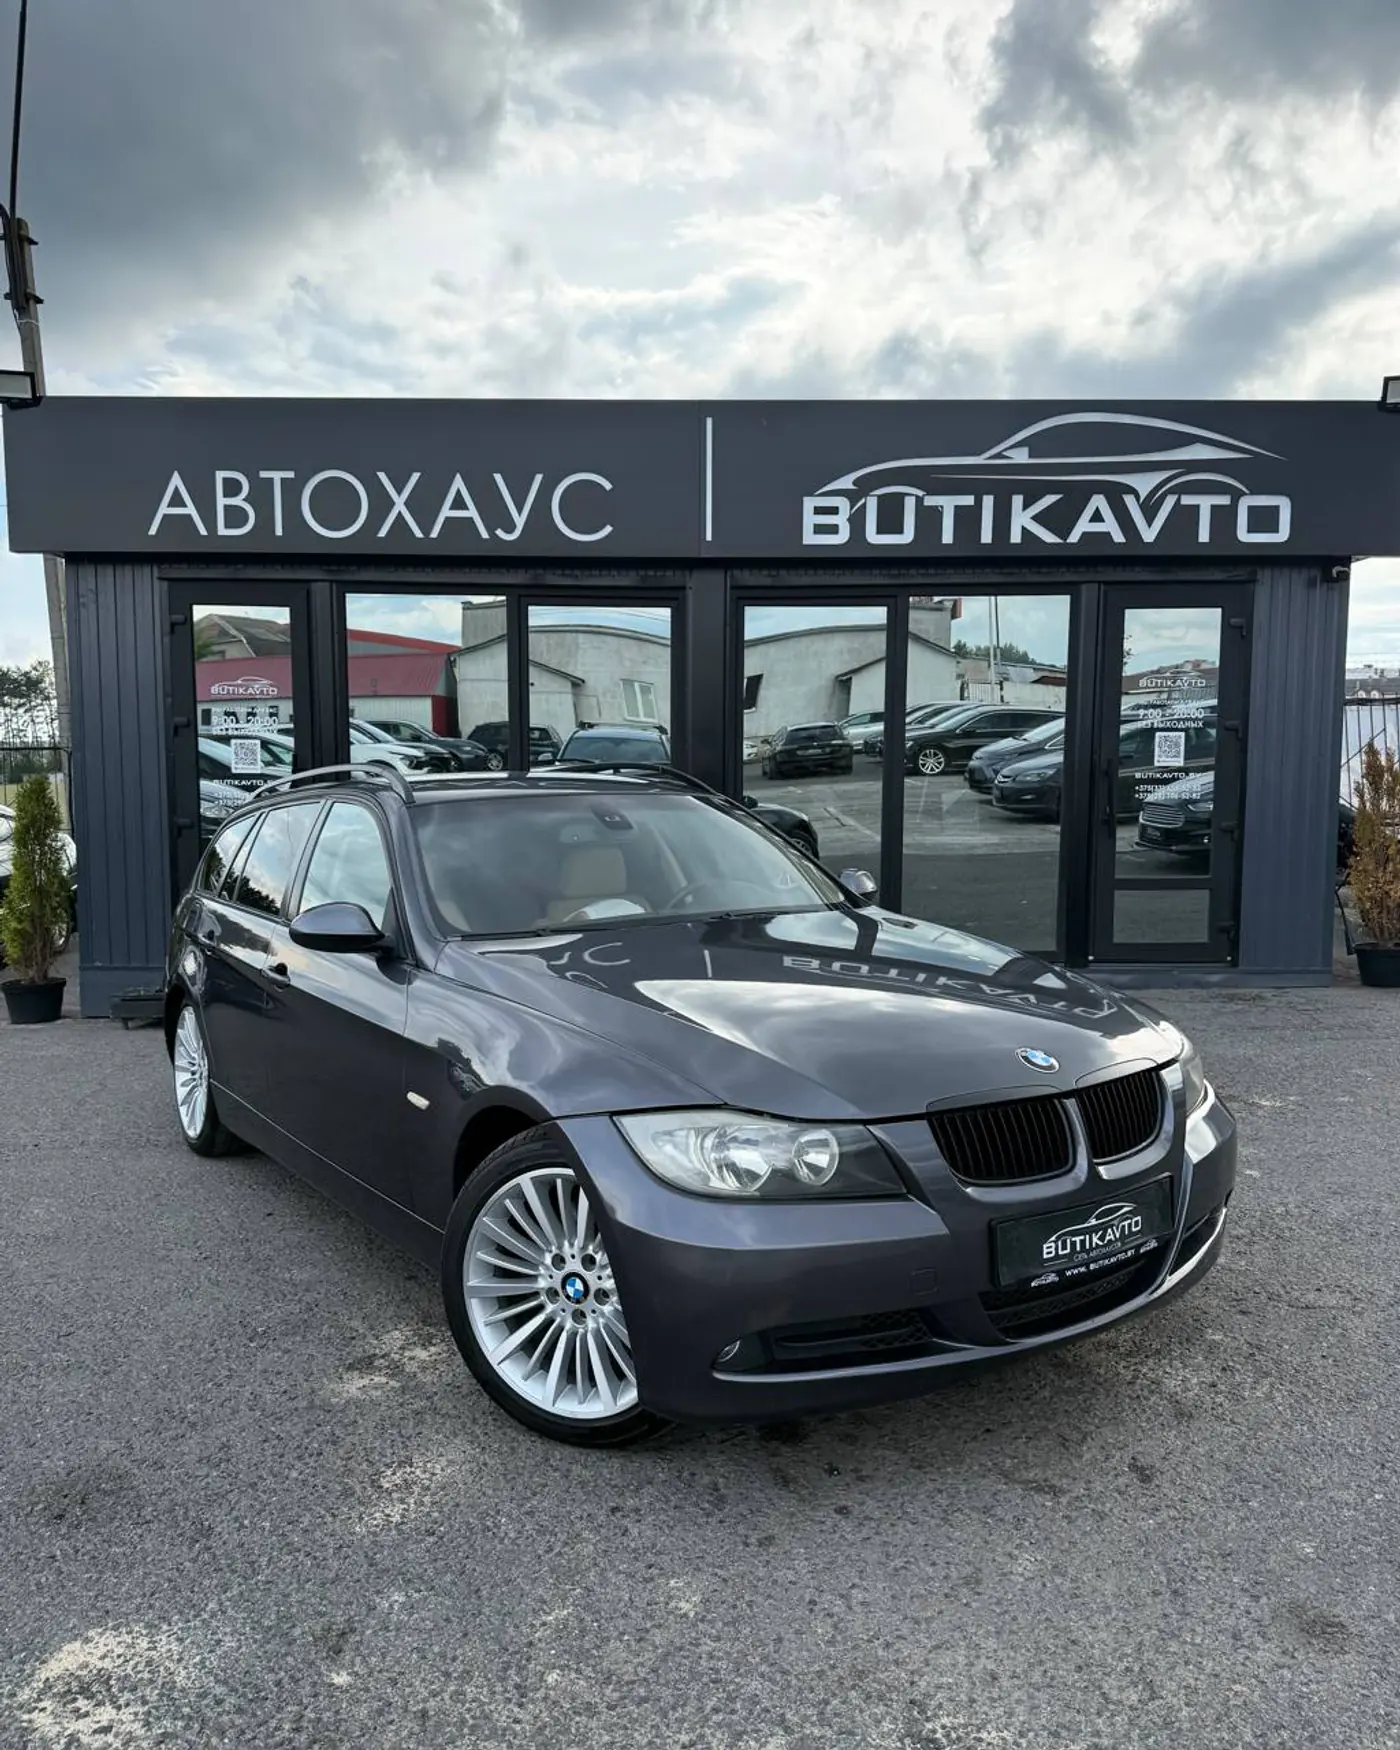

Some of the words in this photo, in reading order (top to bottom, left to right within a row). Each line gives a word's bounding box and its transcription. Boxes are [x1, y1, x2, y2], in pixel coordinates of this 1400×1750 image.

[148, 469, 614, 542] АВТОХАУС
[802, 493, 1292, 545] BUTIKAVTO
[210, 686, 278, 695] BUTIKAVTO
[1138, 679, 1206, 687] BUTIKAVTO
[247, 716, 278, 726] 20:00
[1042, 1215, 1142, 1259] BUTIKAVTO
